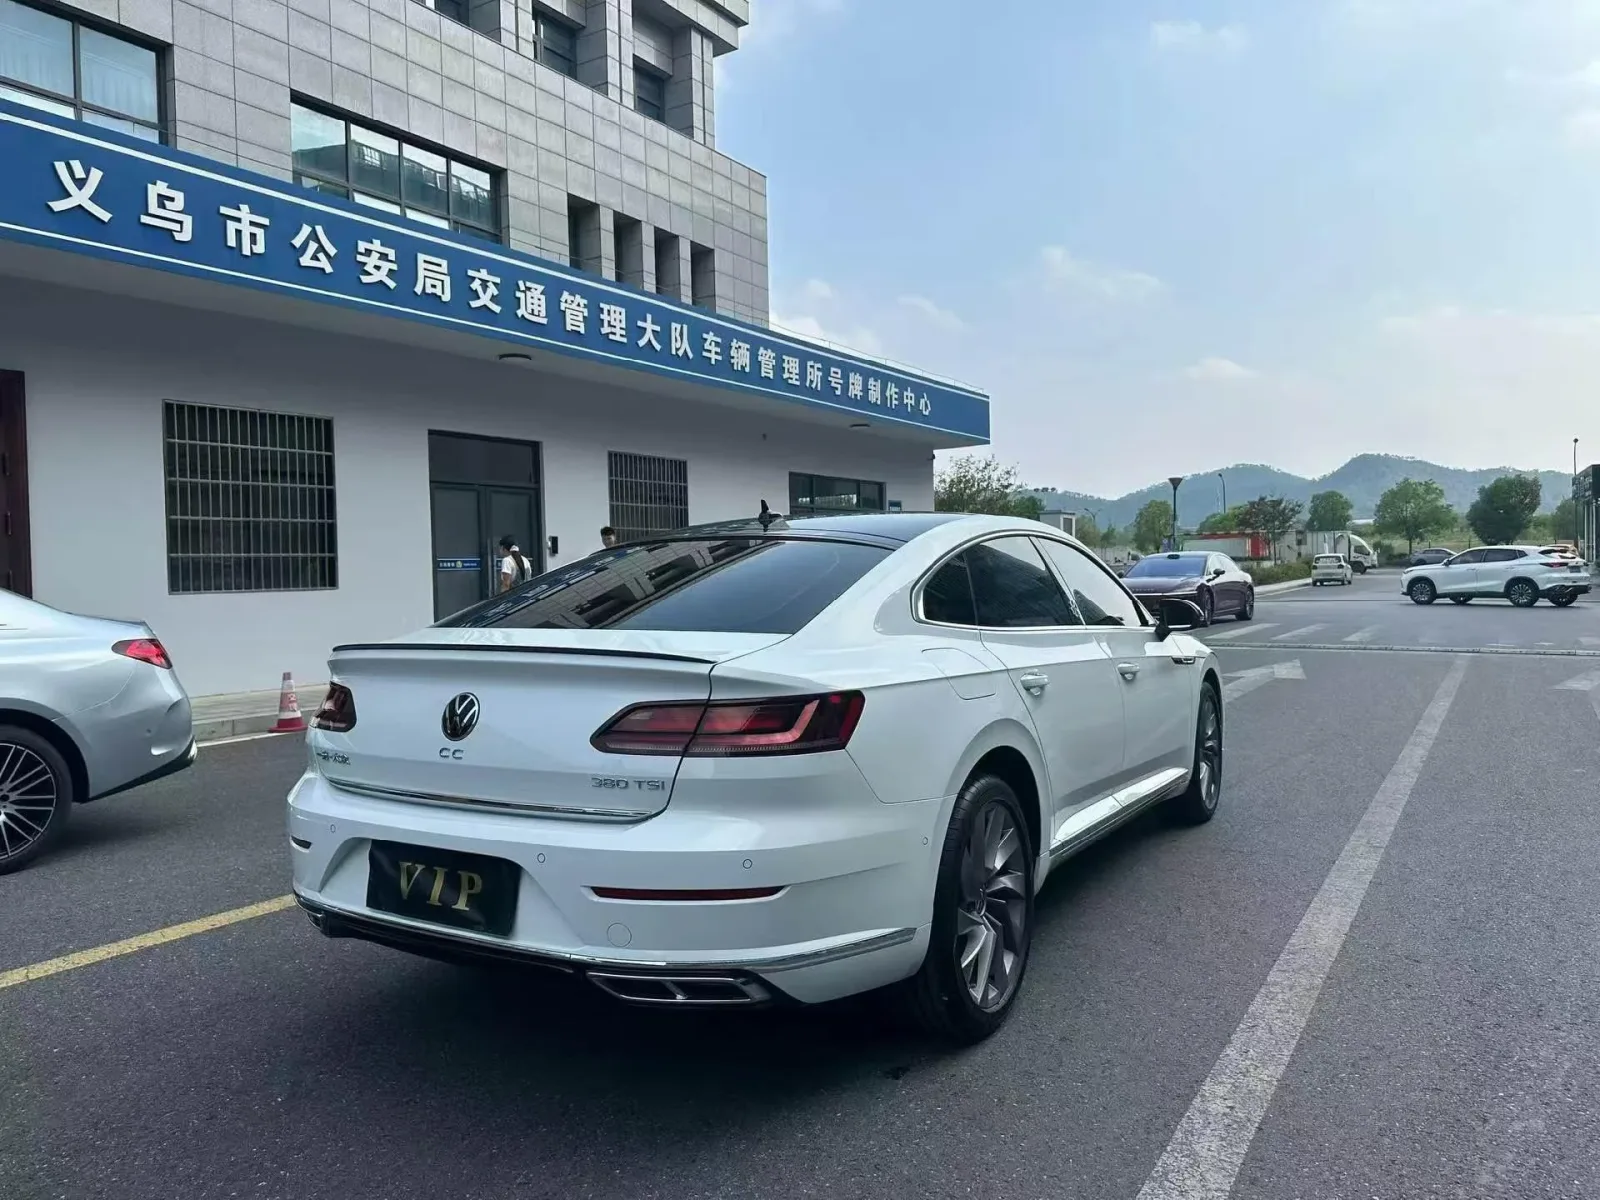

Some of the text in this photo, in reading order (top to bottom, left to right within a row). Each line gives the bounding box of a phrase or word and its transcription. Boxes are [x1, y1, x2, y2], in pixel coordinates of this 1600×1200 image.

[46, 159, 932, 416] 义乌市公安局交通管理大队车辆管理所号牌制作中心
[439, 747, 465, 760] CC
[591, 777, 666, 791] 380 TSI
[399, 861, 483, 911] VIP
